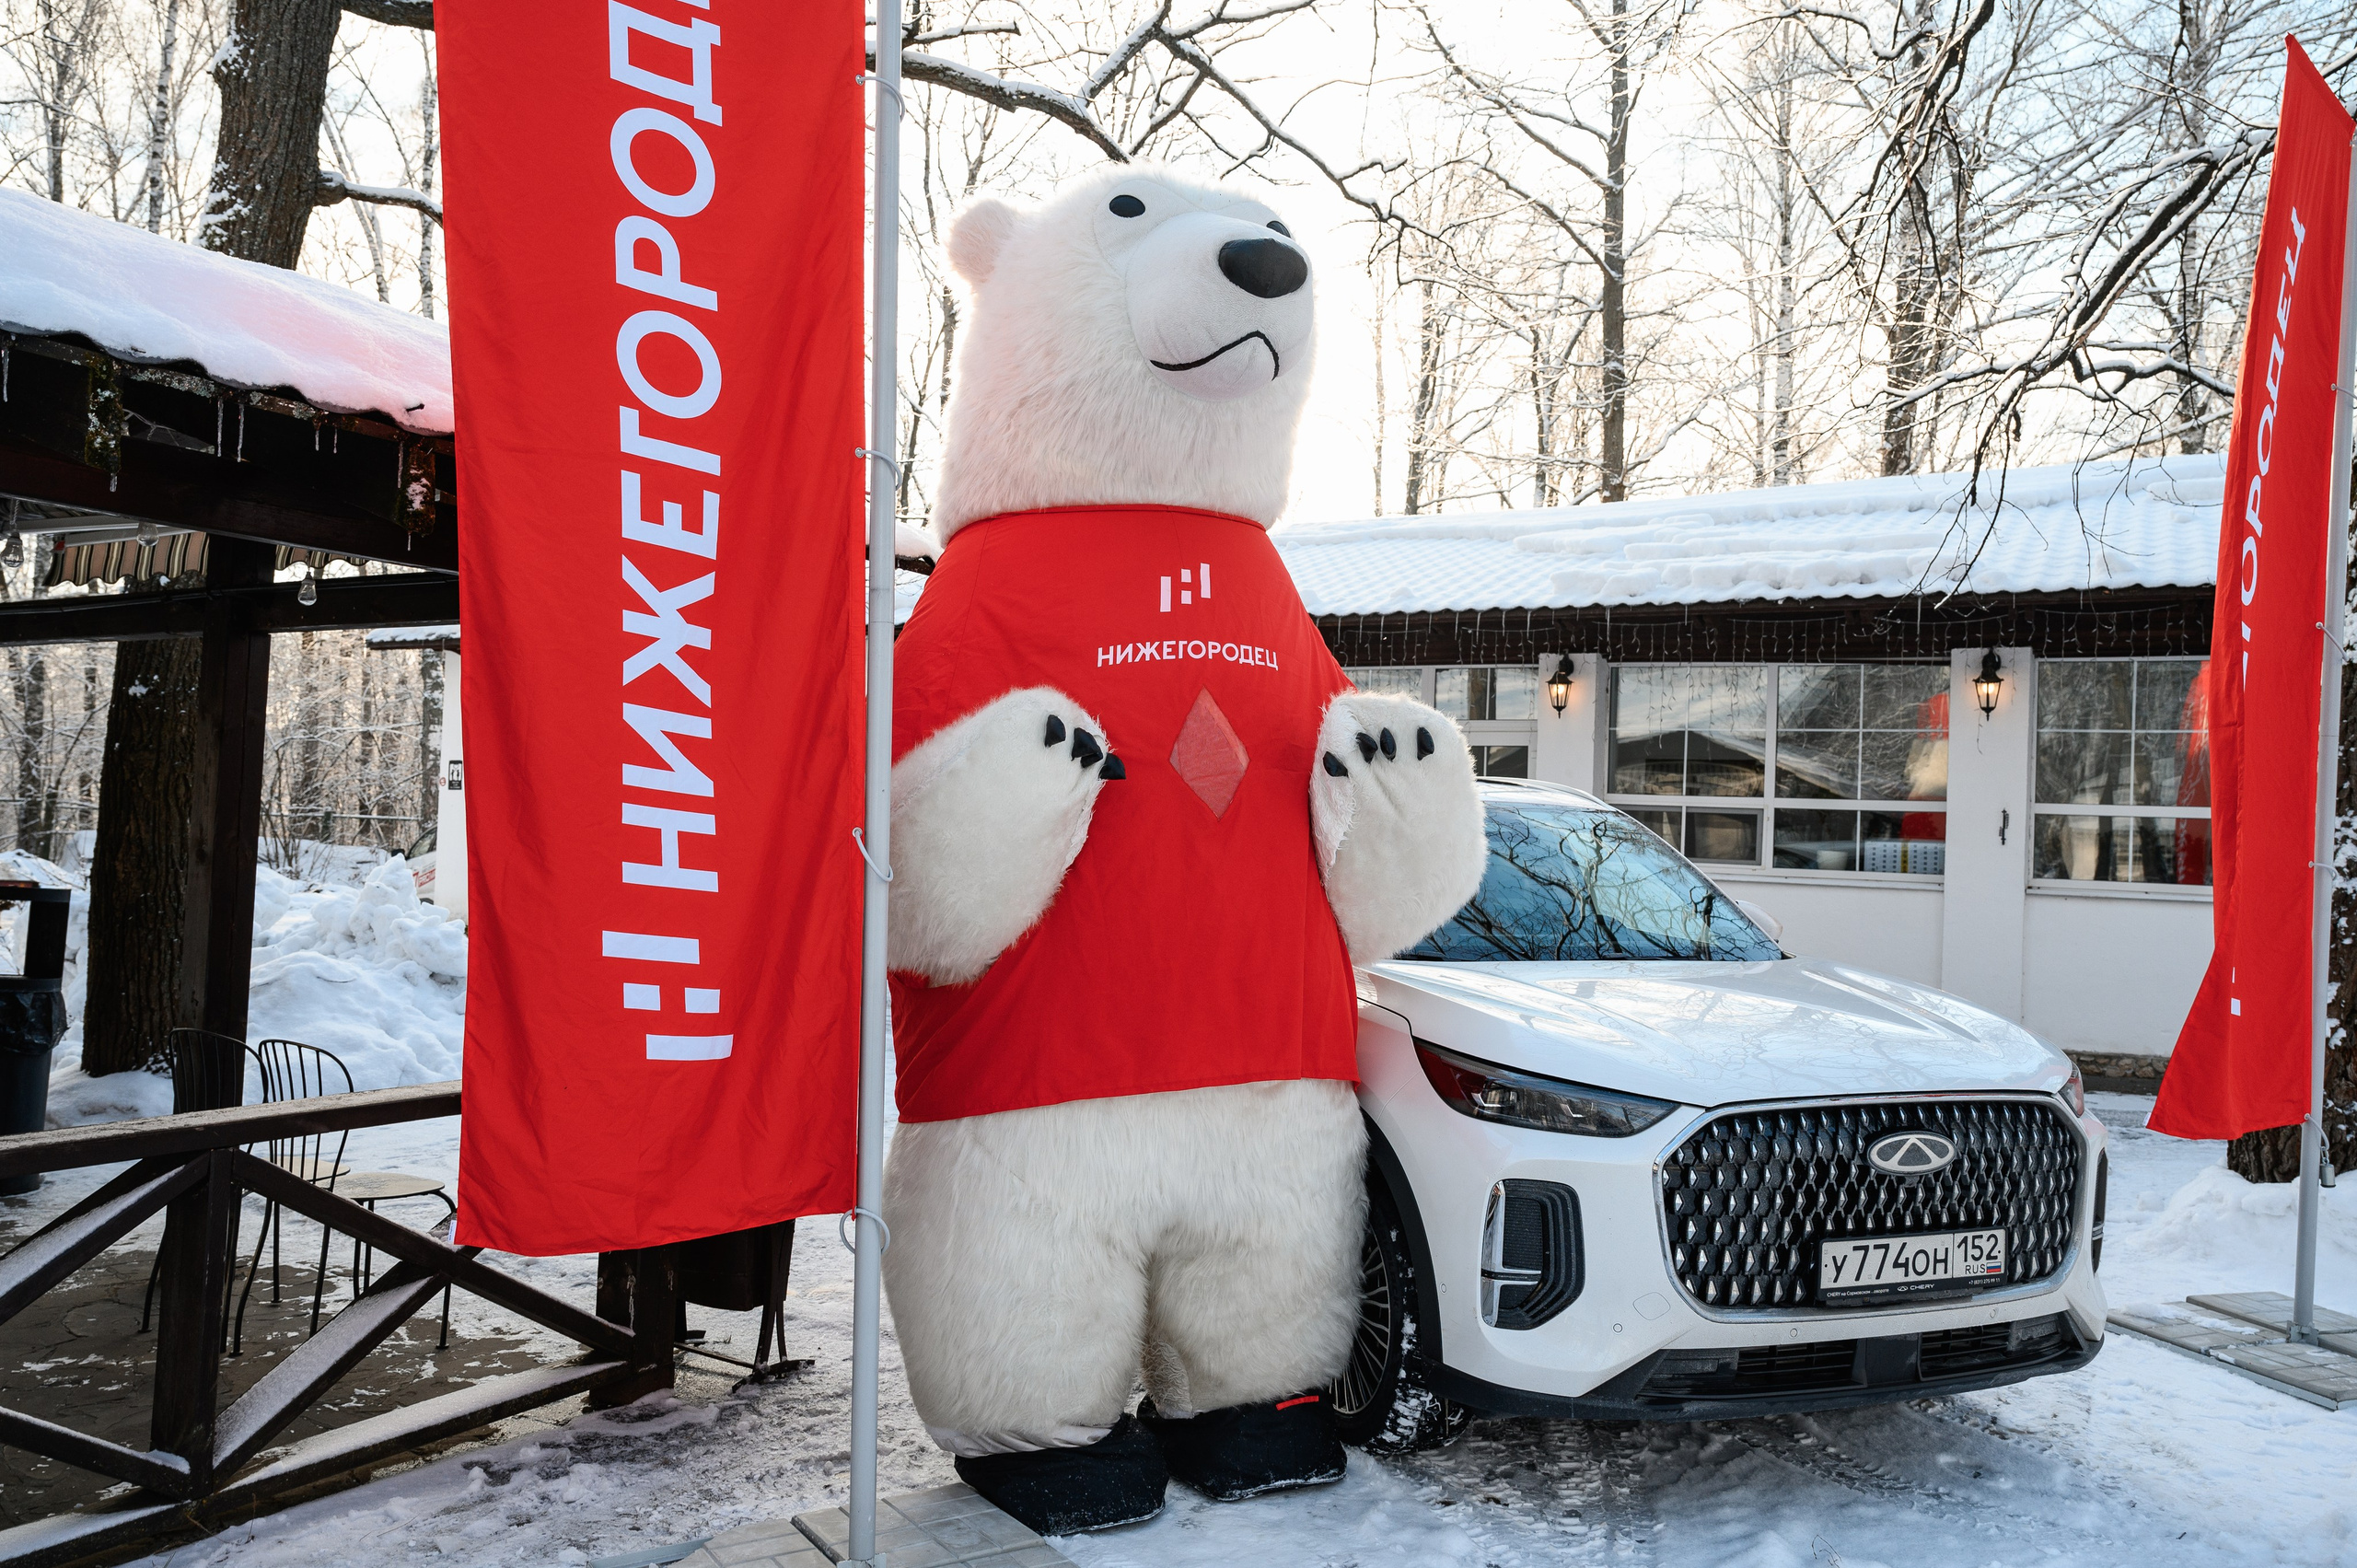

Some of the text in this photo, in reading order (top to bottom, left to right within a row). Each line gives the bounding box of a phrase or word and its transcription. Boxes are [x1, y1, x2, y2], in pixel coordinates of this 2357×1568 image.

[609, 0, 722, 892] НИЖЕГОРОД
[1097, 640, 1279, 671] НИЖЕГОРОДЕЦ
[1831, 1234, 1999, 1283] У774ОН 152
[1965, 1263, 1986, 1274] RUS
